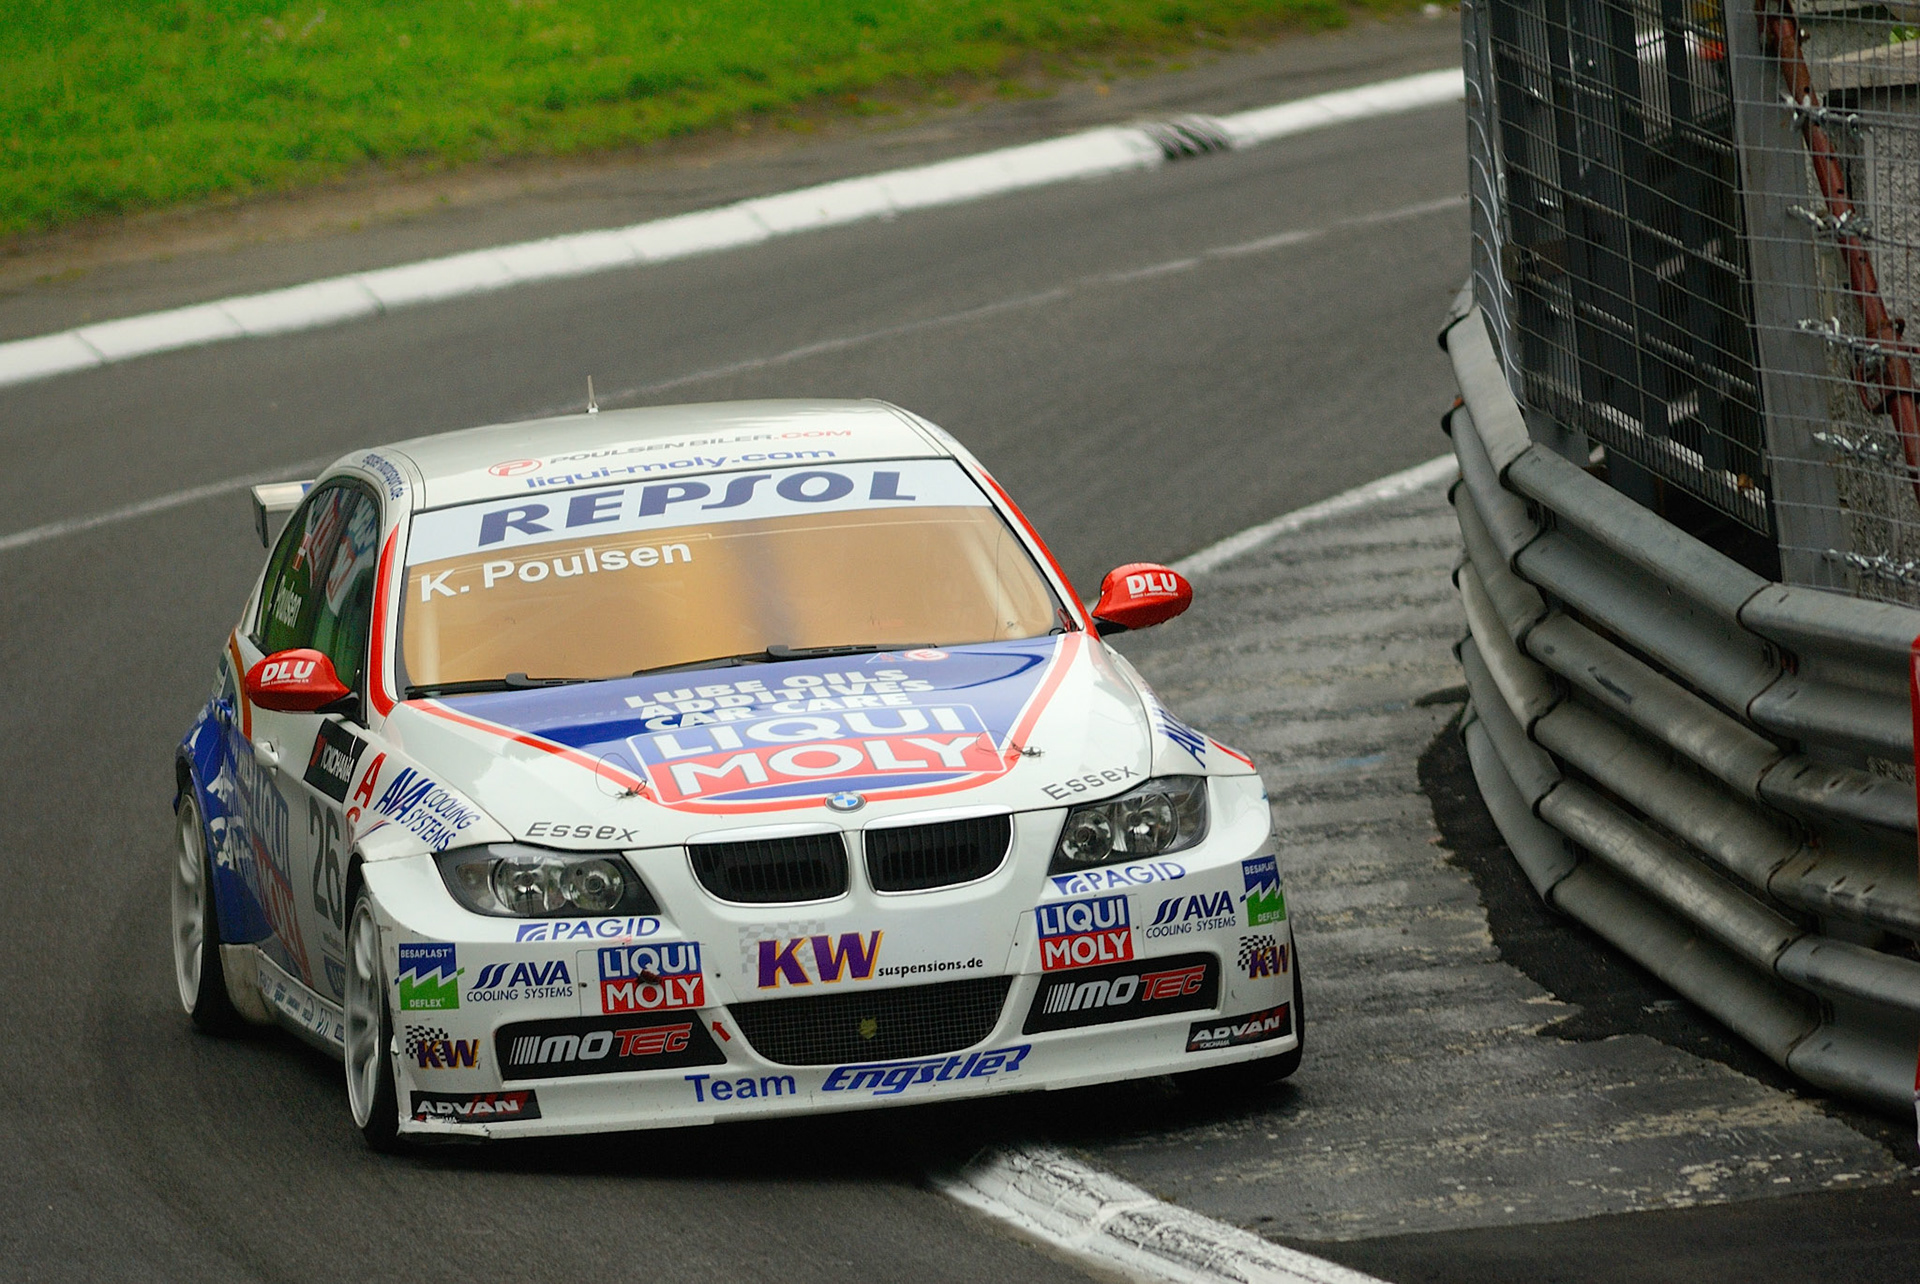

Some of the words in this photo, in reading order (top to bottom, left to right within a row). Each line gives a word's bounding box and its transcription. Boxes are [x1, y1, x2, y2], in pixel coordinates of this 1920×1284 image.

[526, 449, 837, 489] liqui-moly.com
[478, 472, 916, 547] REPSOL
[421, 570, 470, 602] K.
[483, 543, 692, 588] Poulsen
[1126, 573, 1178, 595] DLU
[261, 661, 317, 682] DLU
[624, 680, 764, 709] LUBE
[782, 669, 910, 688] OILS
[640, 679, 935, 720] ADDITIVES
[644, 706, 755, 731] CAR
[771, 693, 913, 714] CARE
[653, 708, 967, 760] LIQUI
[669, 737, 975, 796] MOLY
[1041, 766, 1140, 801] Essex
[373, 767, 436, 822] AVA
[424, 789, 481, 829] COOLING
[401, 808, 456, 850] SYSTEMS
[525, 821, 640, 843] Essex
[308, 795, 343, 930] 26
[1085, 862, 1186, 890] PAGID
[1040, 898, 1127, 936] LIQUI
[1184, 890, 1235, 921] AVA
[551, 916, 660, 940] PAGID
[1146, 924, 1192, 939] COOLING
[1196, 916, 1236, 931] SYSTEMS
[400, 949, 448, 959] BESAPLAST
[603, 944, 698, 977] LIQUI
[759, 930, 884, 989] KW
[877, 958, 984, 977] suspensions.de
[1045, 931, 1129, 969] MOLY
[1248, 942, 1290, 979] KW
[508, 960, 571, 988] AVA
[409, 999, 442, 1008] DEFLEX
[466, 989, 519, 1003] COOLING
[524, 986, 573, 1000] SYSTEMS
[607, 977, 702, 1011] MOLY
[1191, 1014, 1281, 1043] ADVAN
[417, 1038, 480, 1070] KW
[684, 1073, 797, 1102] Team
[820, 1044, 1032, 1096] Engstler
[416, 1099, 521, 1115] ADVAN
